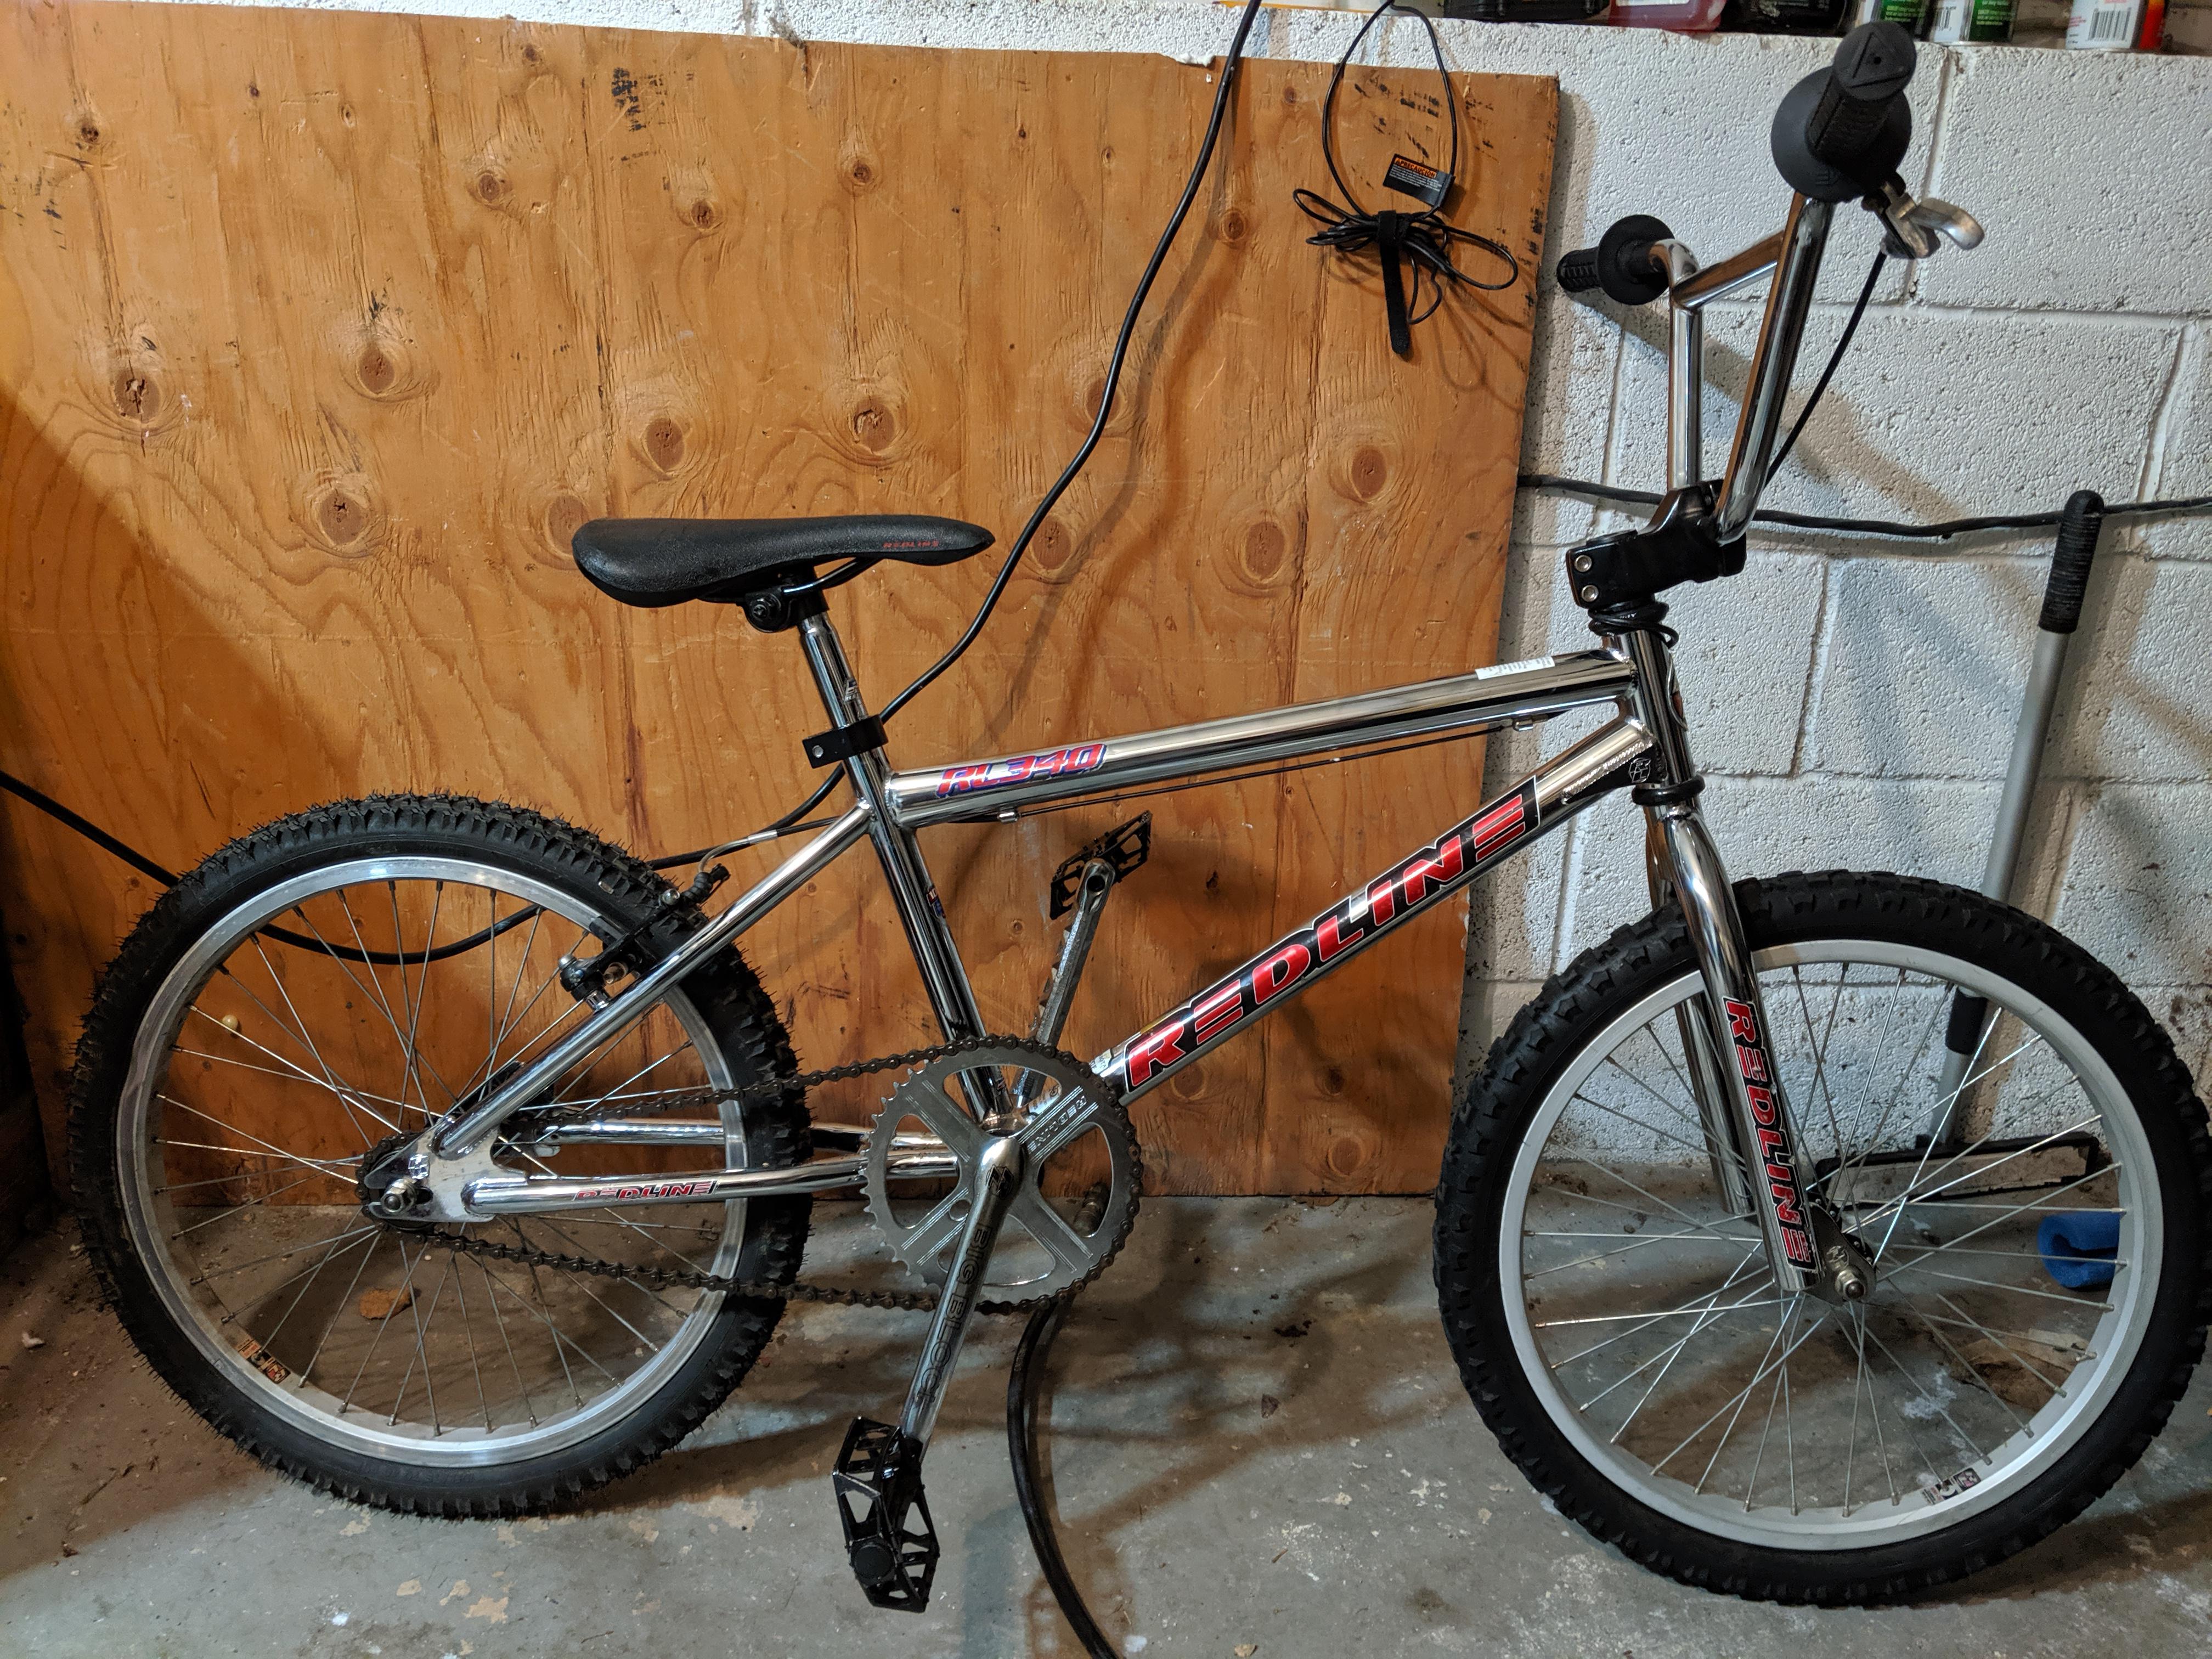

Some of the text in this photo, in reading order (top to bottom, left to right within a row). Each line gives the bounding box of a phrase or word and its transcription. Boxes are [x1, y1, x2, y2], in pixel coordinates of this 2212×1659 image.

[1129, 794, 1525, 1087] REDLINE
[957, 1223, 993, 1286] BIG
[1725, 1000, 1810, 1263] REDLINE
